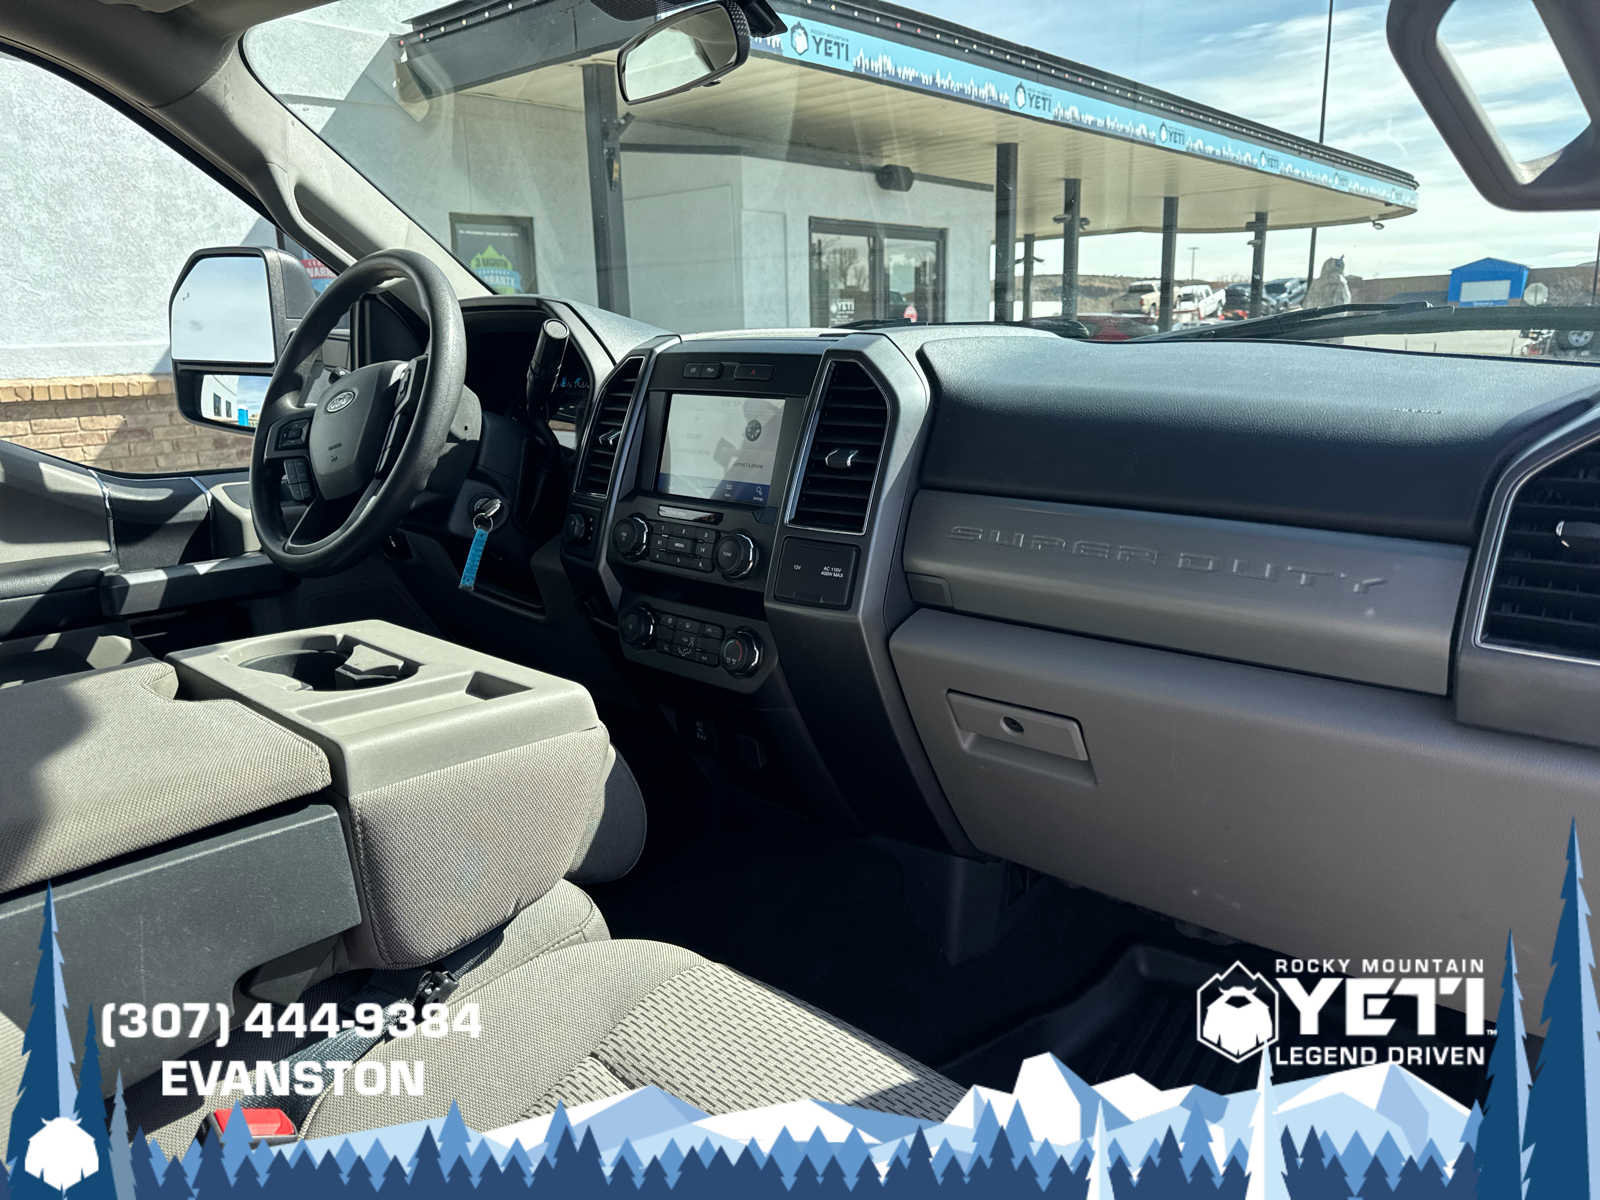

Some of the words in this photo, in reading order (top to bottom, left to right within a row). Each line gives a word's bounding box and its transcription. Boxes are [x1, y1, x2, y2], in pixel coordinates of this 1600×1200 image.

[811, 35, 849, 61] YETI
[1027, 92, 1052, 112] YETI
[948, 525, 1160, 566] SUPER
[1178, 551, 1389, 593] DUTY
